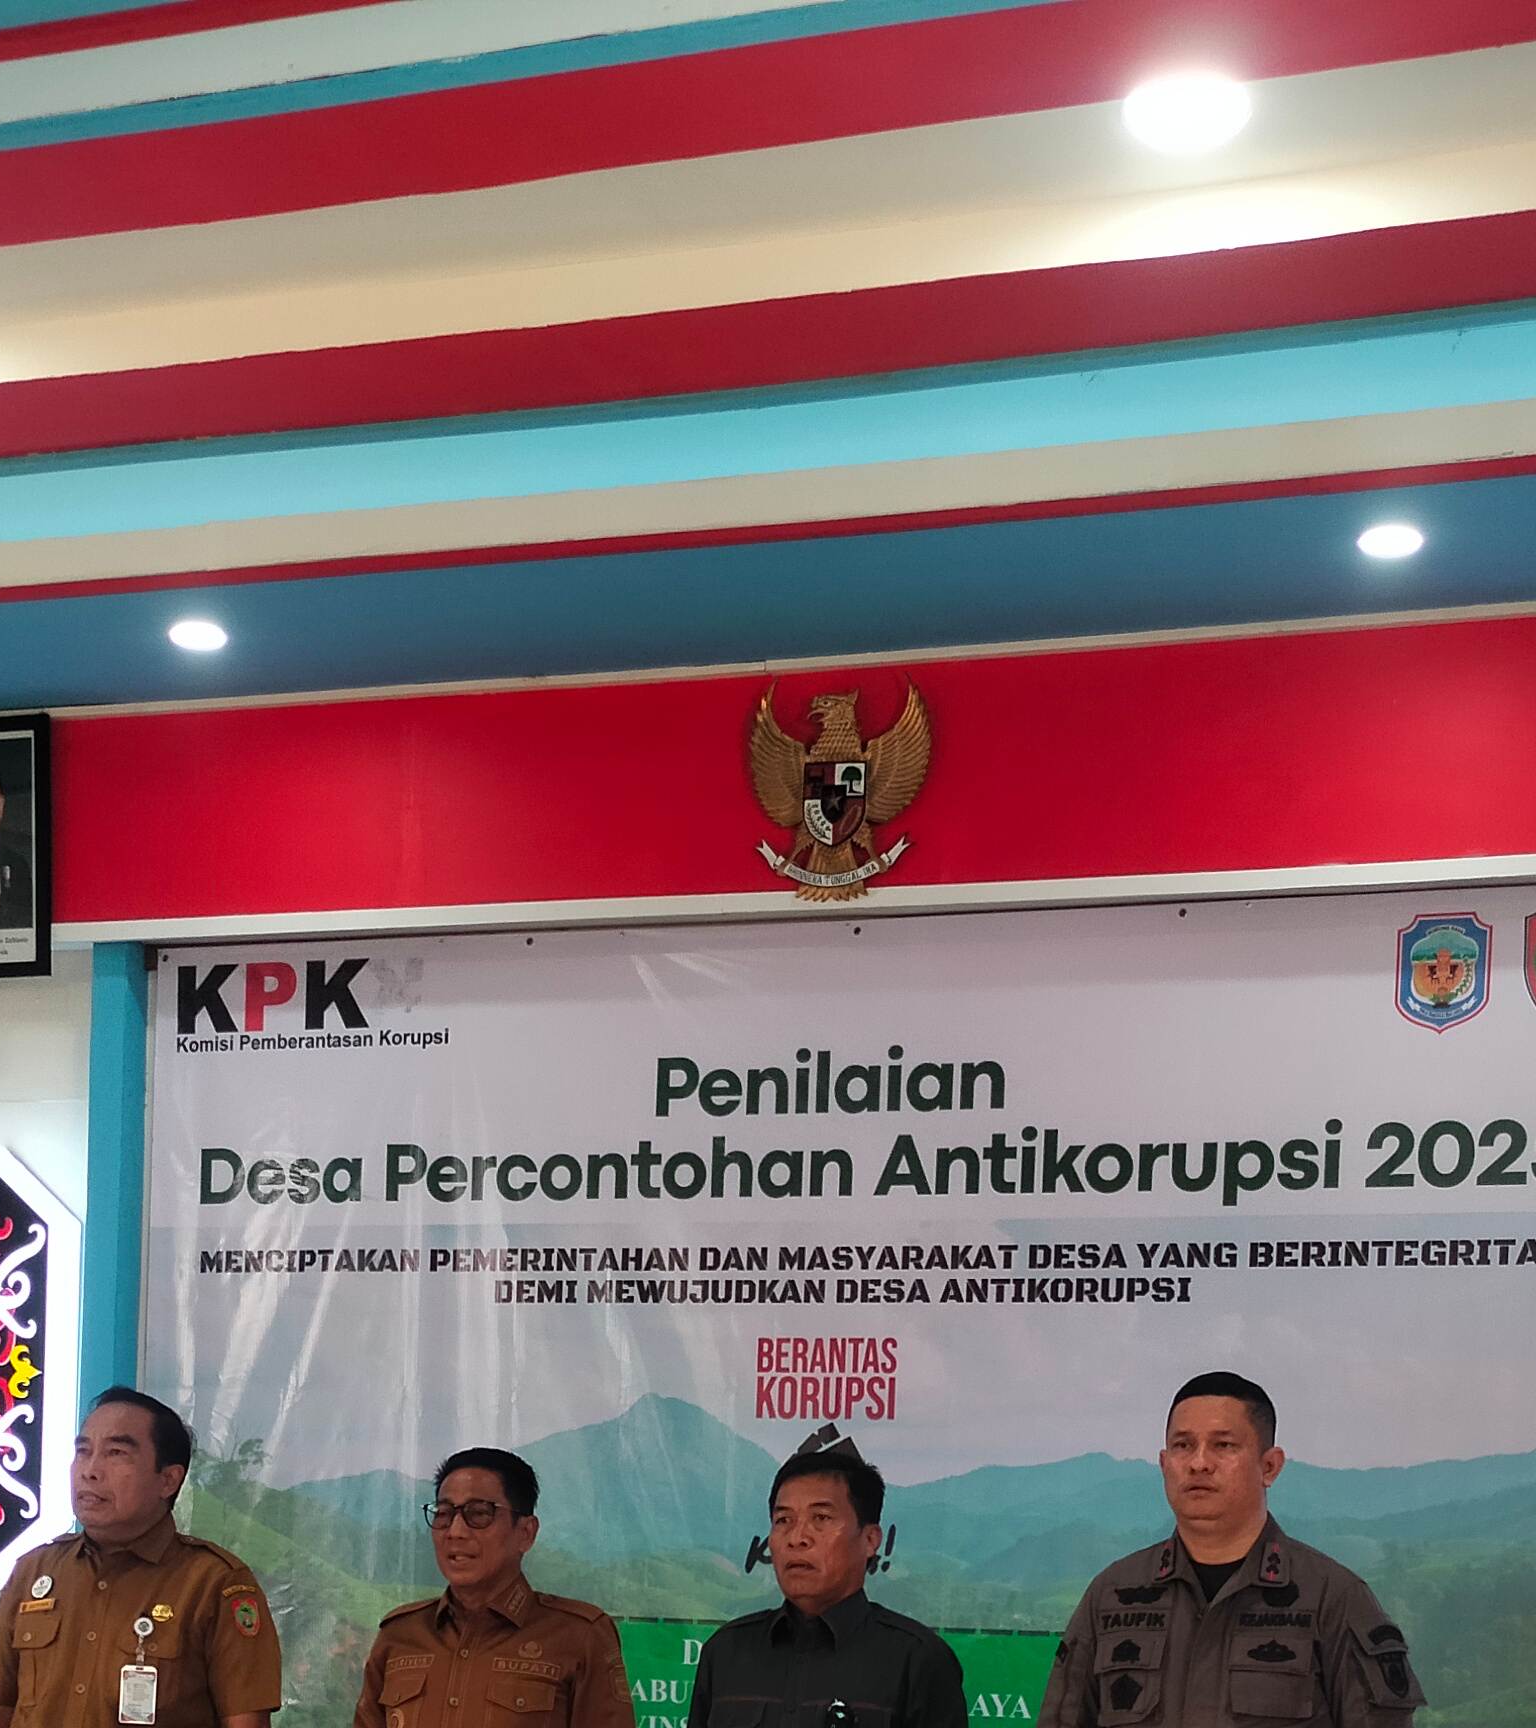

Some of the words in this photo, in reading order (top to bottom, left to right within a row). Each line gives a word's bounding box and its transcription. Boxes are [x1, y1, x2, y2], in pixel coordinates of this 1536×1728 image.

[177, 957, 371, 1035] KPK
[176, 1034, 234, 1053] Komisi
[239, 1030, 374, 1051] Pemberantasan
[379, 1027, 449, 1050] Korupsi
[655, 1044, 1006, 1118] Penilaian
[199, 1147, 363, 1205] Desa
[385, 1135, 854, 1203] Percontohan
[872, 1118, 1343, 1207] Antikorupsi
[199, 1248, 420, 1274] MENCIPTAKAN
[429, 1247, 690, 1273] PEMERINTAHAN
[698, 1246, 769, 1272] DAN
[778, 1244, 1019, 1271] MASYARAKAT
[1028, 1243, 1128, 1270] DESA
[1136, 1242, 1239, 1269] YANG
[494, 1279, 578, 1304] DEMI
[586, 1279, 826, 1304] MEWUJUDKAN
[836, 1278, 931, 1304] DESA
[939, 1277, 1192, 1304] ANTIKORUPSI
[756, 1337, 898, 1374] BERANTAS
[755, 1375, 896, 1421] KORUPSI
[1101, 1612, 1167, 1631] TAUFIK
[496, 1659, 557, 1677] BUPATI
[967, 1693, 1032, 1720] AYA
